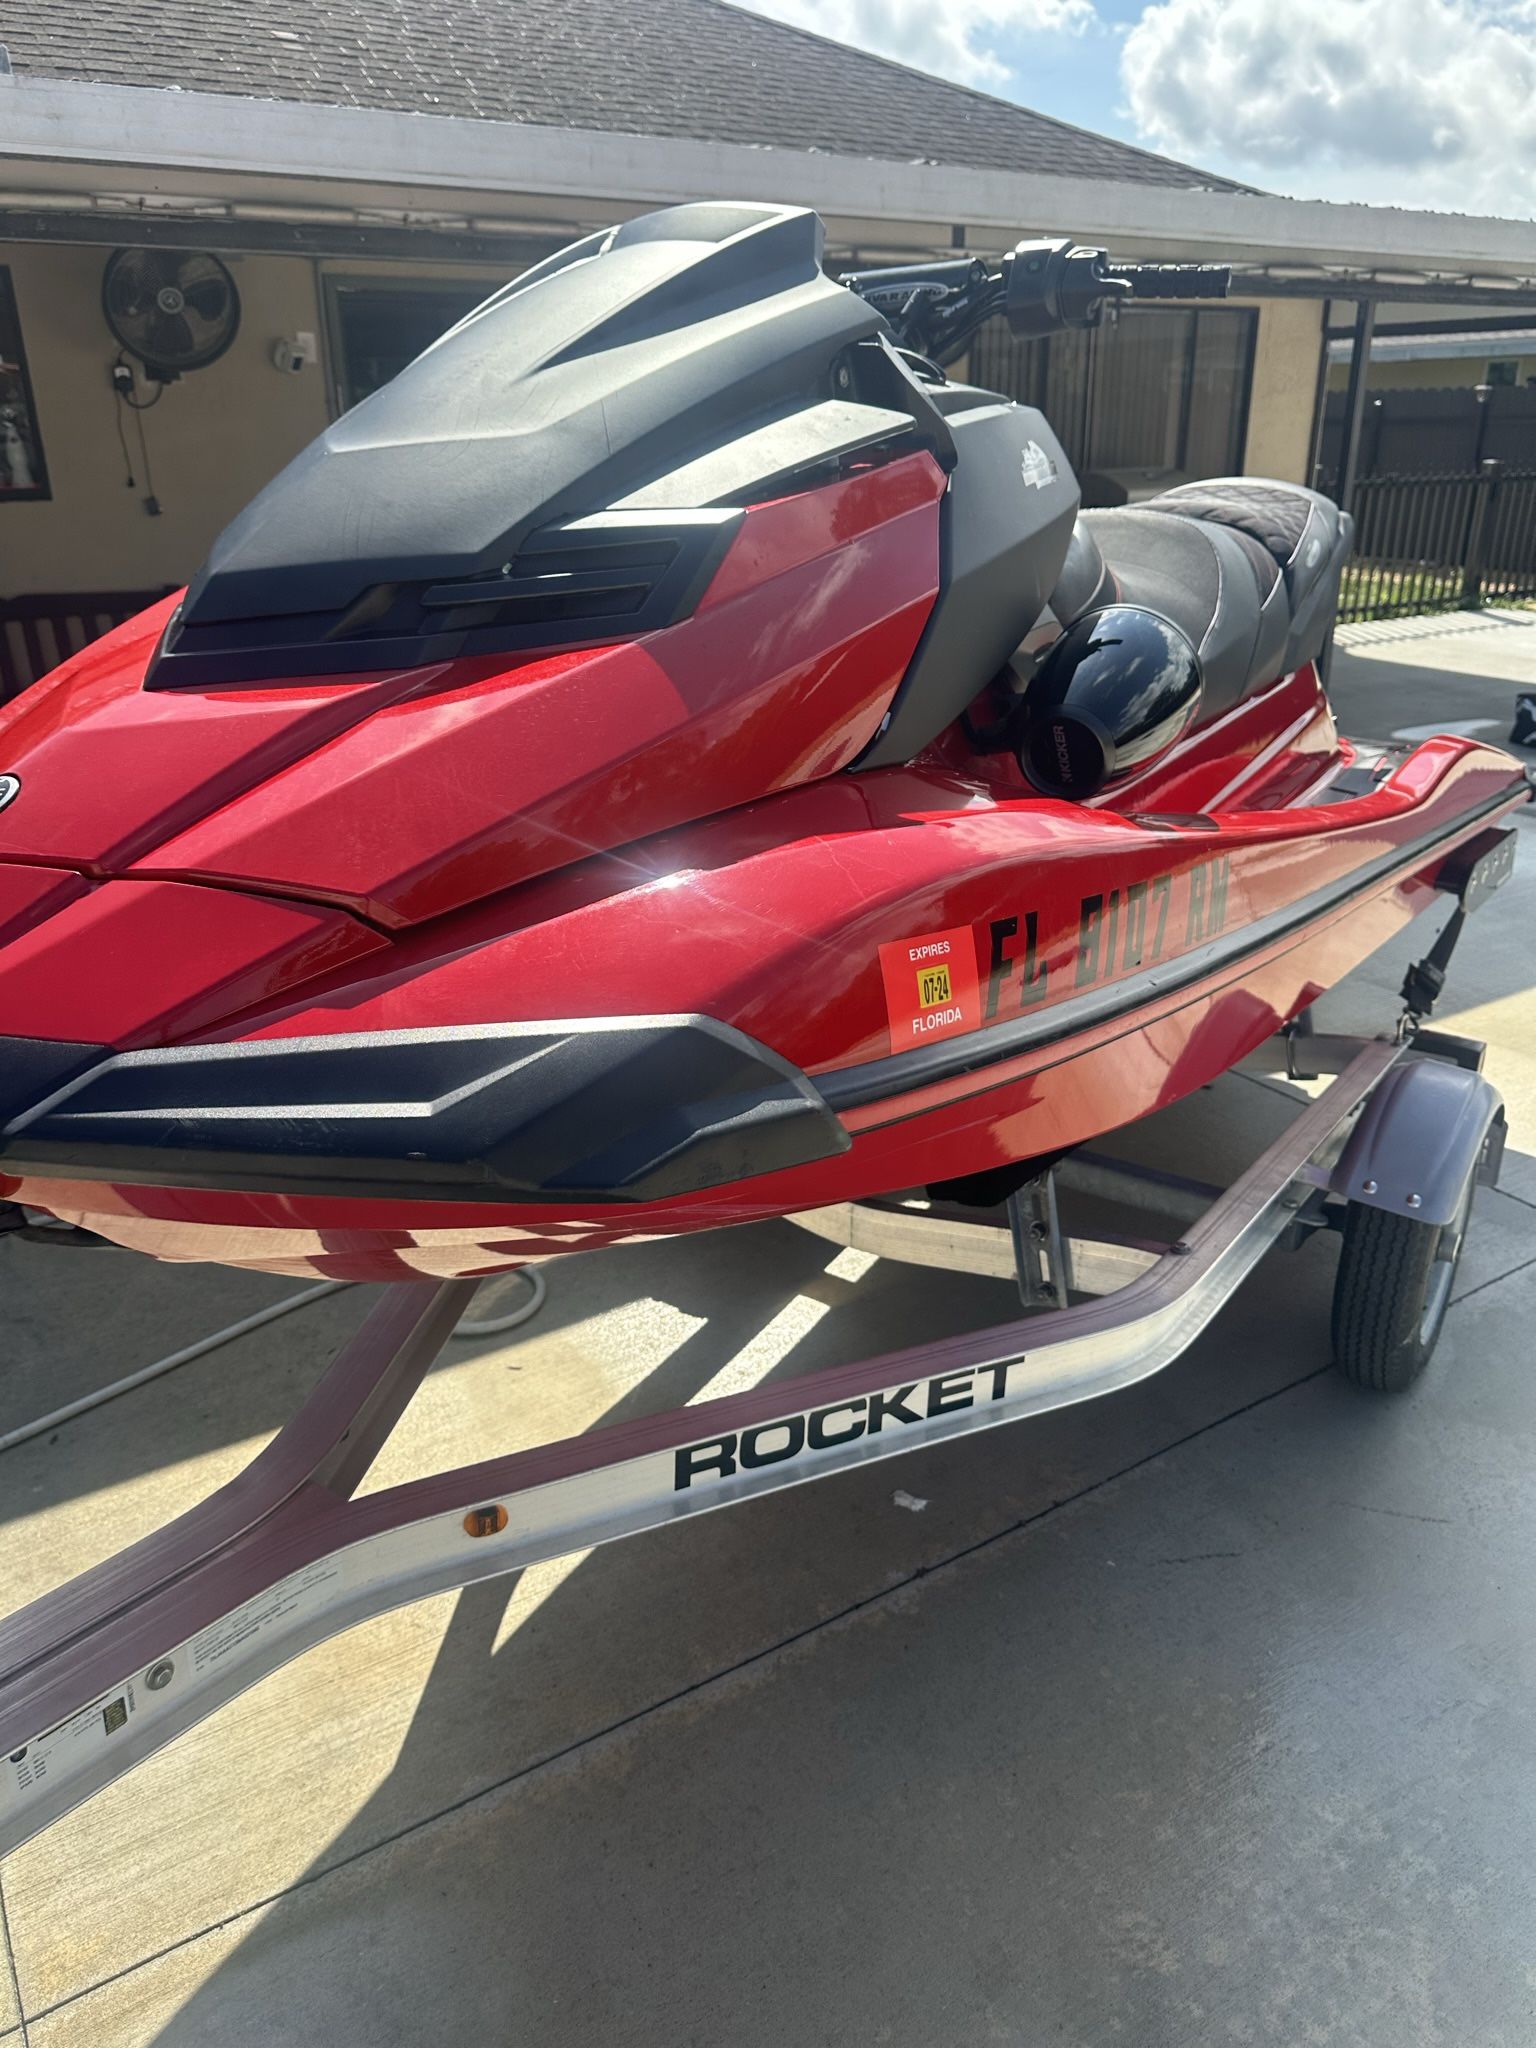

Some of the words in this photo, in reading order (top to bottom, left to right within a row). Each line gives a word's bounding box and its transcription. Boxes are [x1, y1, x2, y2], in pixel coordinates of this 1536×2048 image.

[1053, 725, 1071, 773] KICKER
[908, 940, 951, 961] EXPIRES
[985, 911, 1048, 1020] FL
[1075, 873, 1172, 989] 8107
[924, 974, 949, 1004] 07-24
[912, 1007, 963, 1035] FLORIDA
[674, 1355, 1026, 1491] ROCKET
